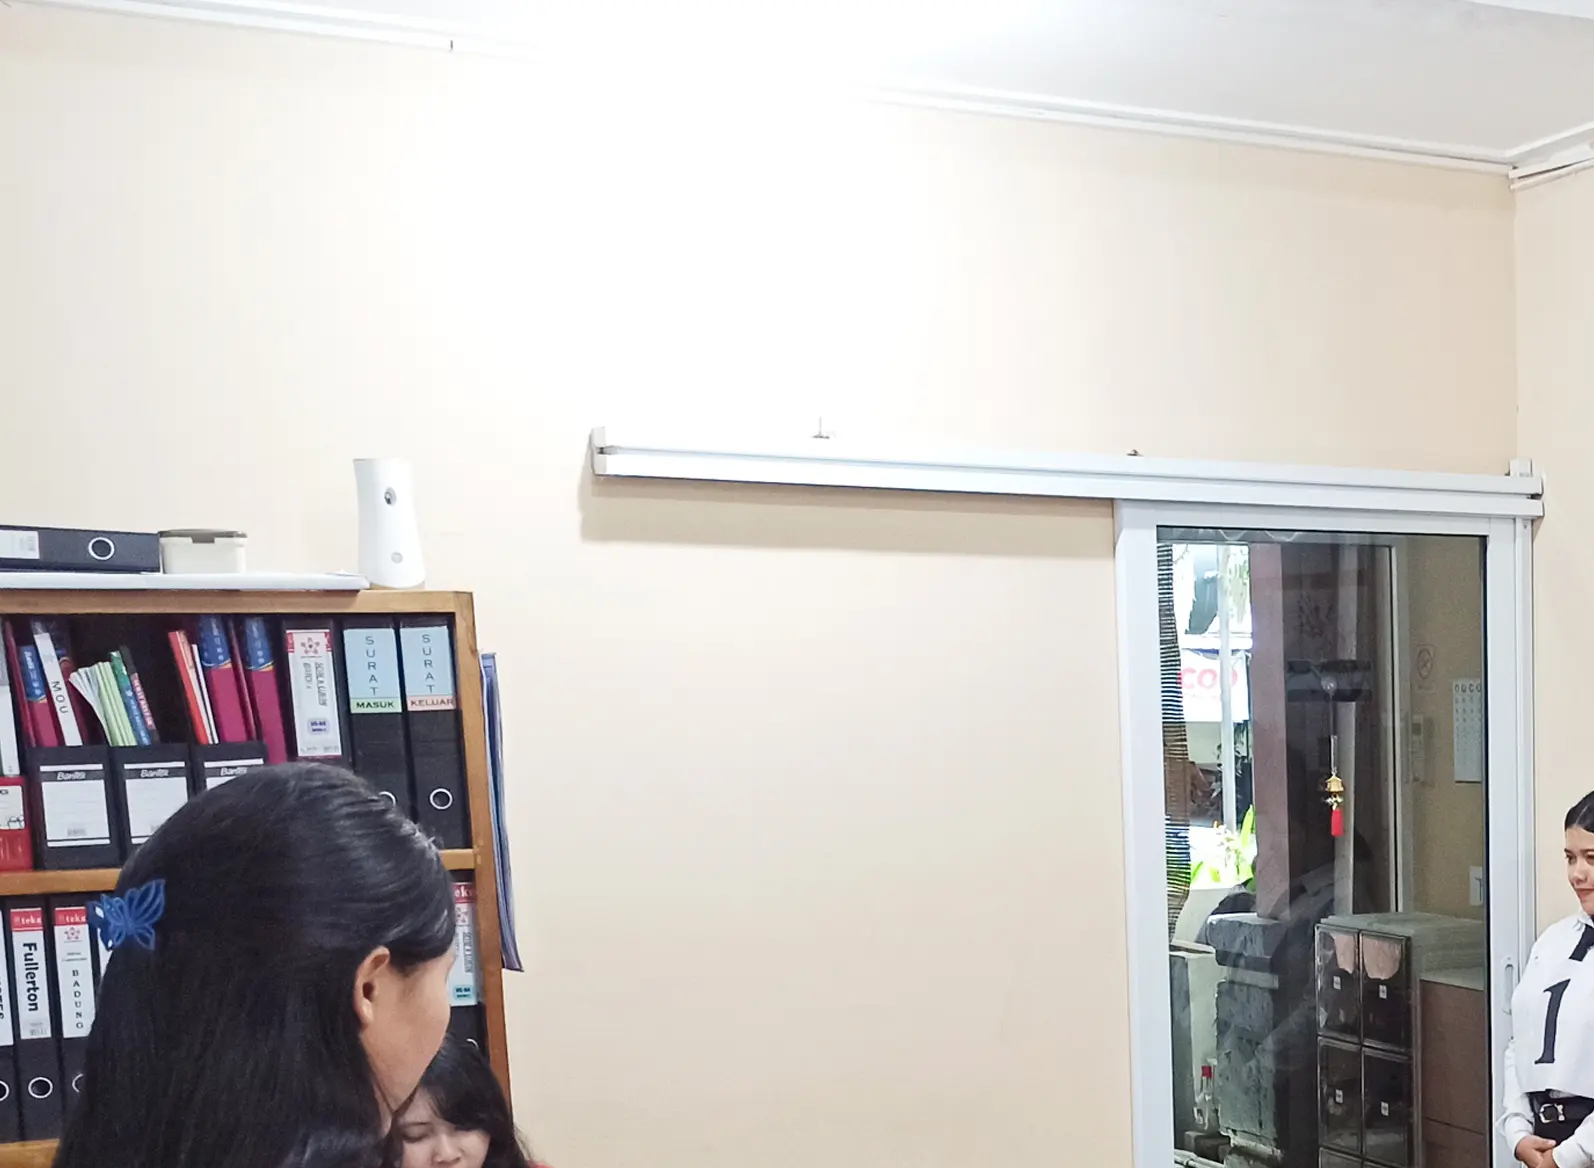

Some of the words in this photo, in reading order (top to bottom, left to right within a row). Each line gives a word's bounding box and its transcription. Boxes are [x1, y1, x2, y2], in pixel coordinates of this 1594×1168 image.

[365, 635, 378, 696] SURAT
[421, 633, 435, 694] SURAT
[51, 680, 69, 715] MOU
[356, 700, 395, 709] MASUK
[410, 698, 454, 708] KELUAR
[22, 942, 41, 1013] Fullerton
[72, 969, 85, 1030] BADUNG
[1534, 978, 1572, 1065] 1
